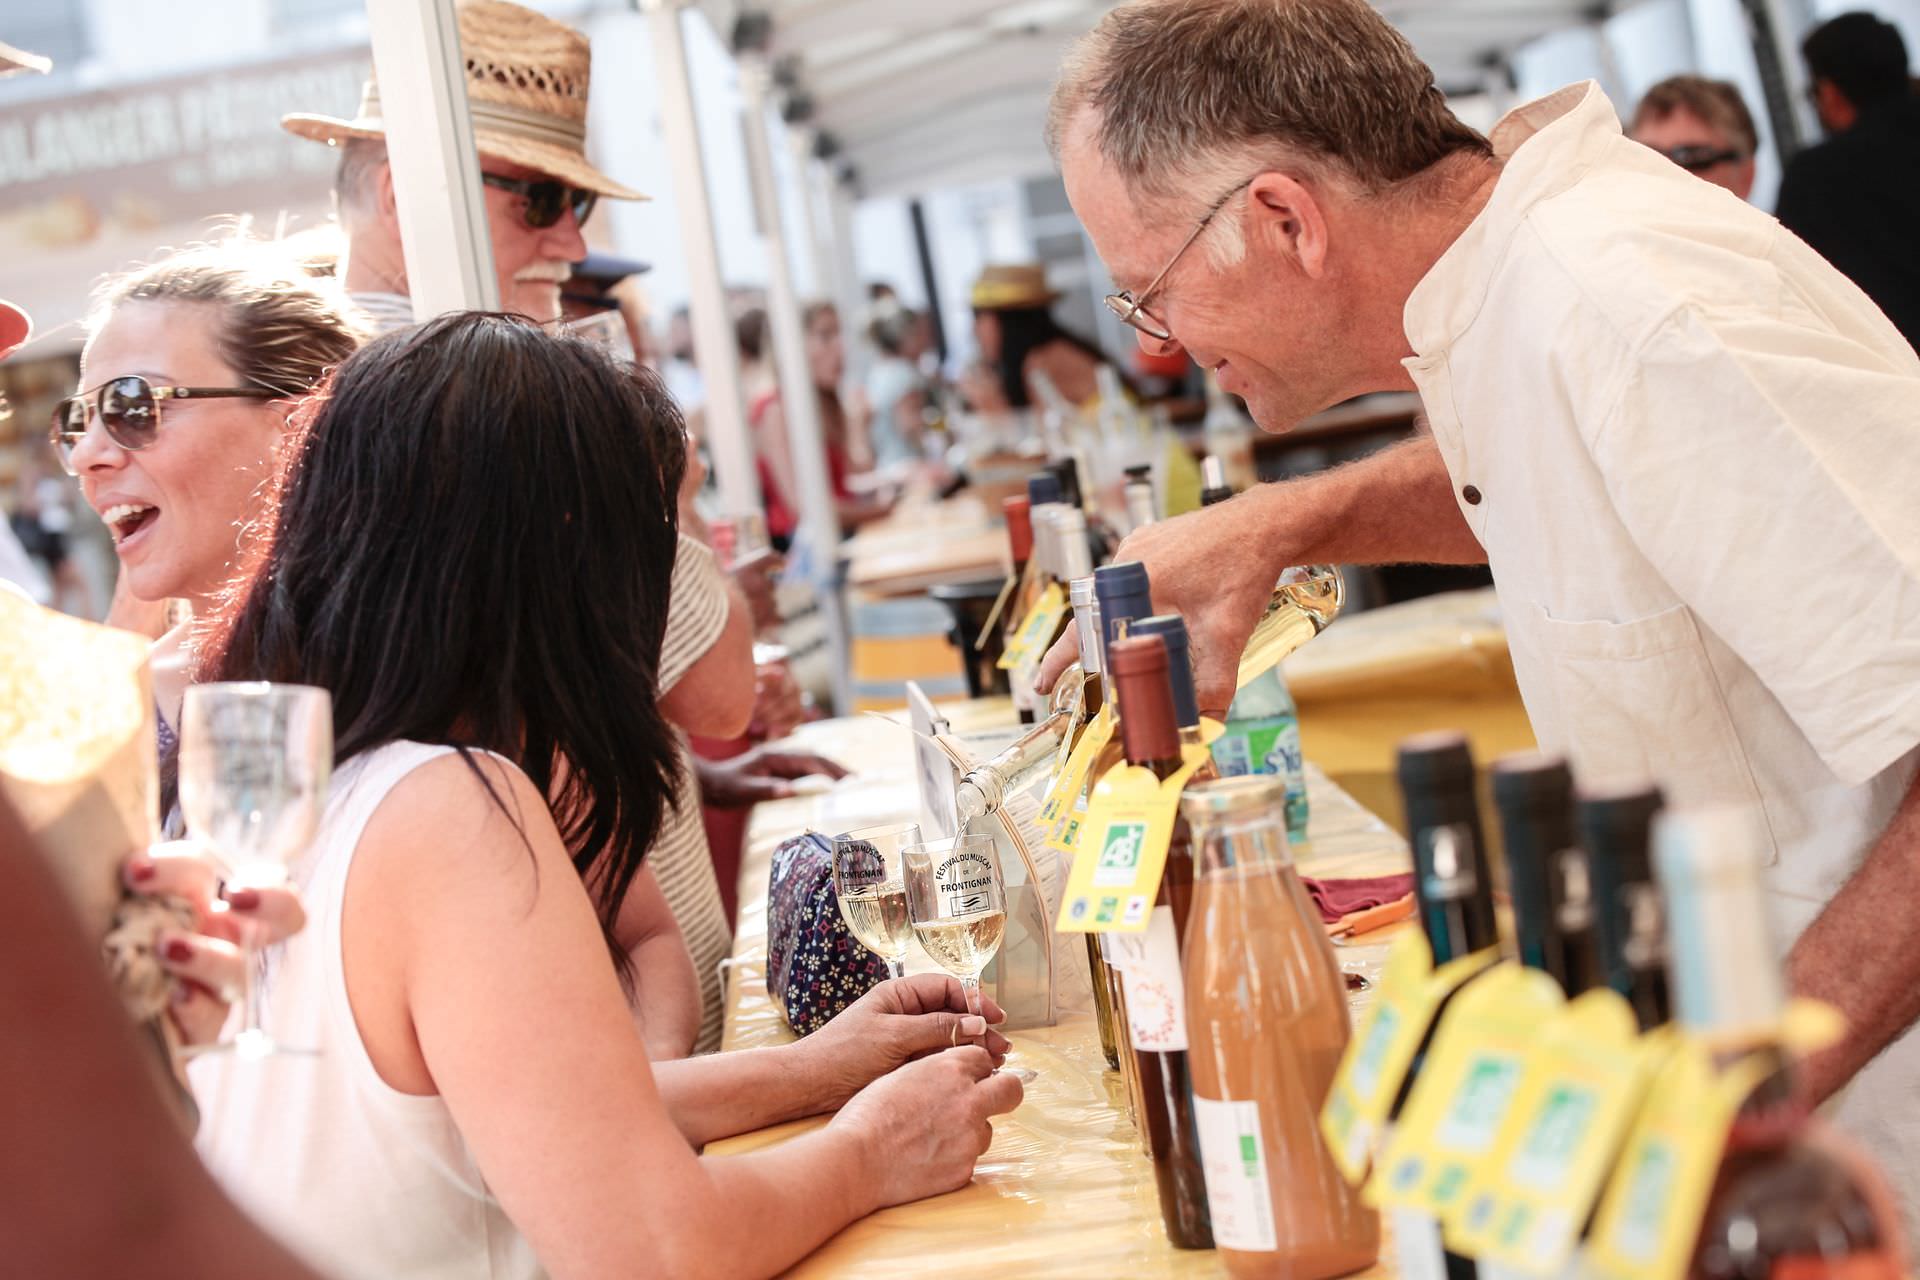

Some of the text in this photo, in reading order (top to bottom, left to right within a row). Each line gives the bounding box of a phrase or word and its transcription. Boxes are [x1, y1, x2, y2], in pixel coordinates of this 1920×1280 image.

[860, 845, 886, 863] MUSCAT
[838, 869, 883, 880] FRONTIGNAN
[936, 853, 992, 880] FESTIVAL DU MUSCAT
[941, 875, 992, 893] FRONTIGNAN
